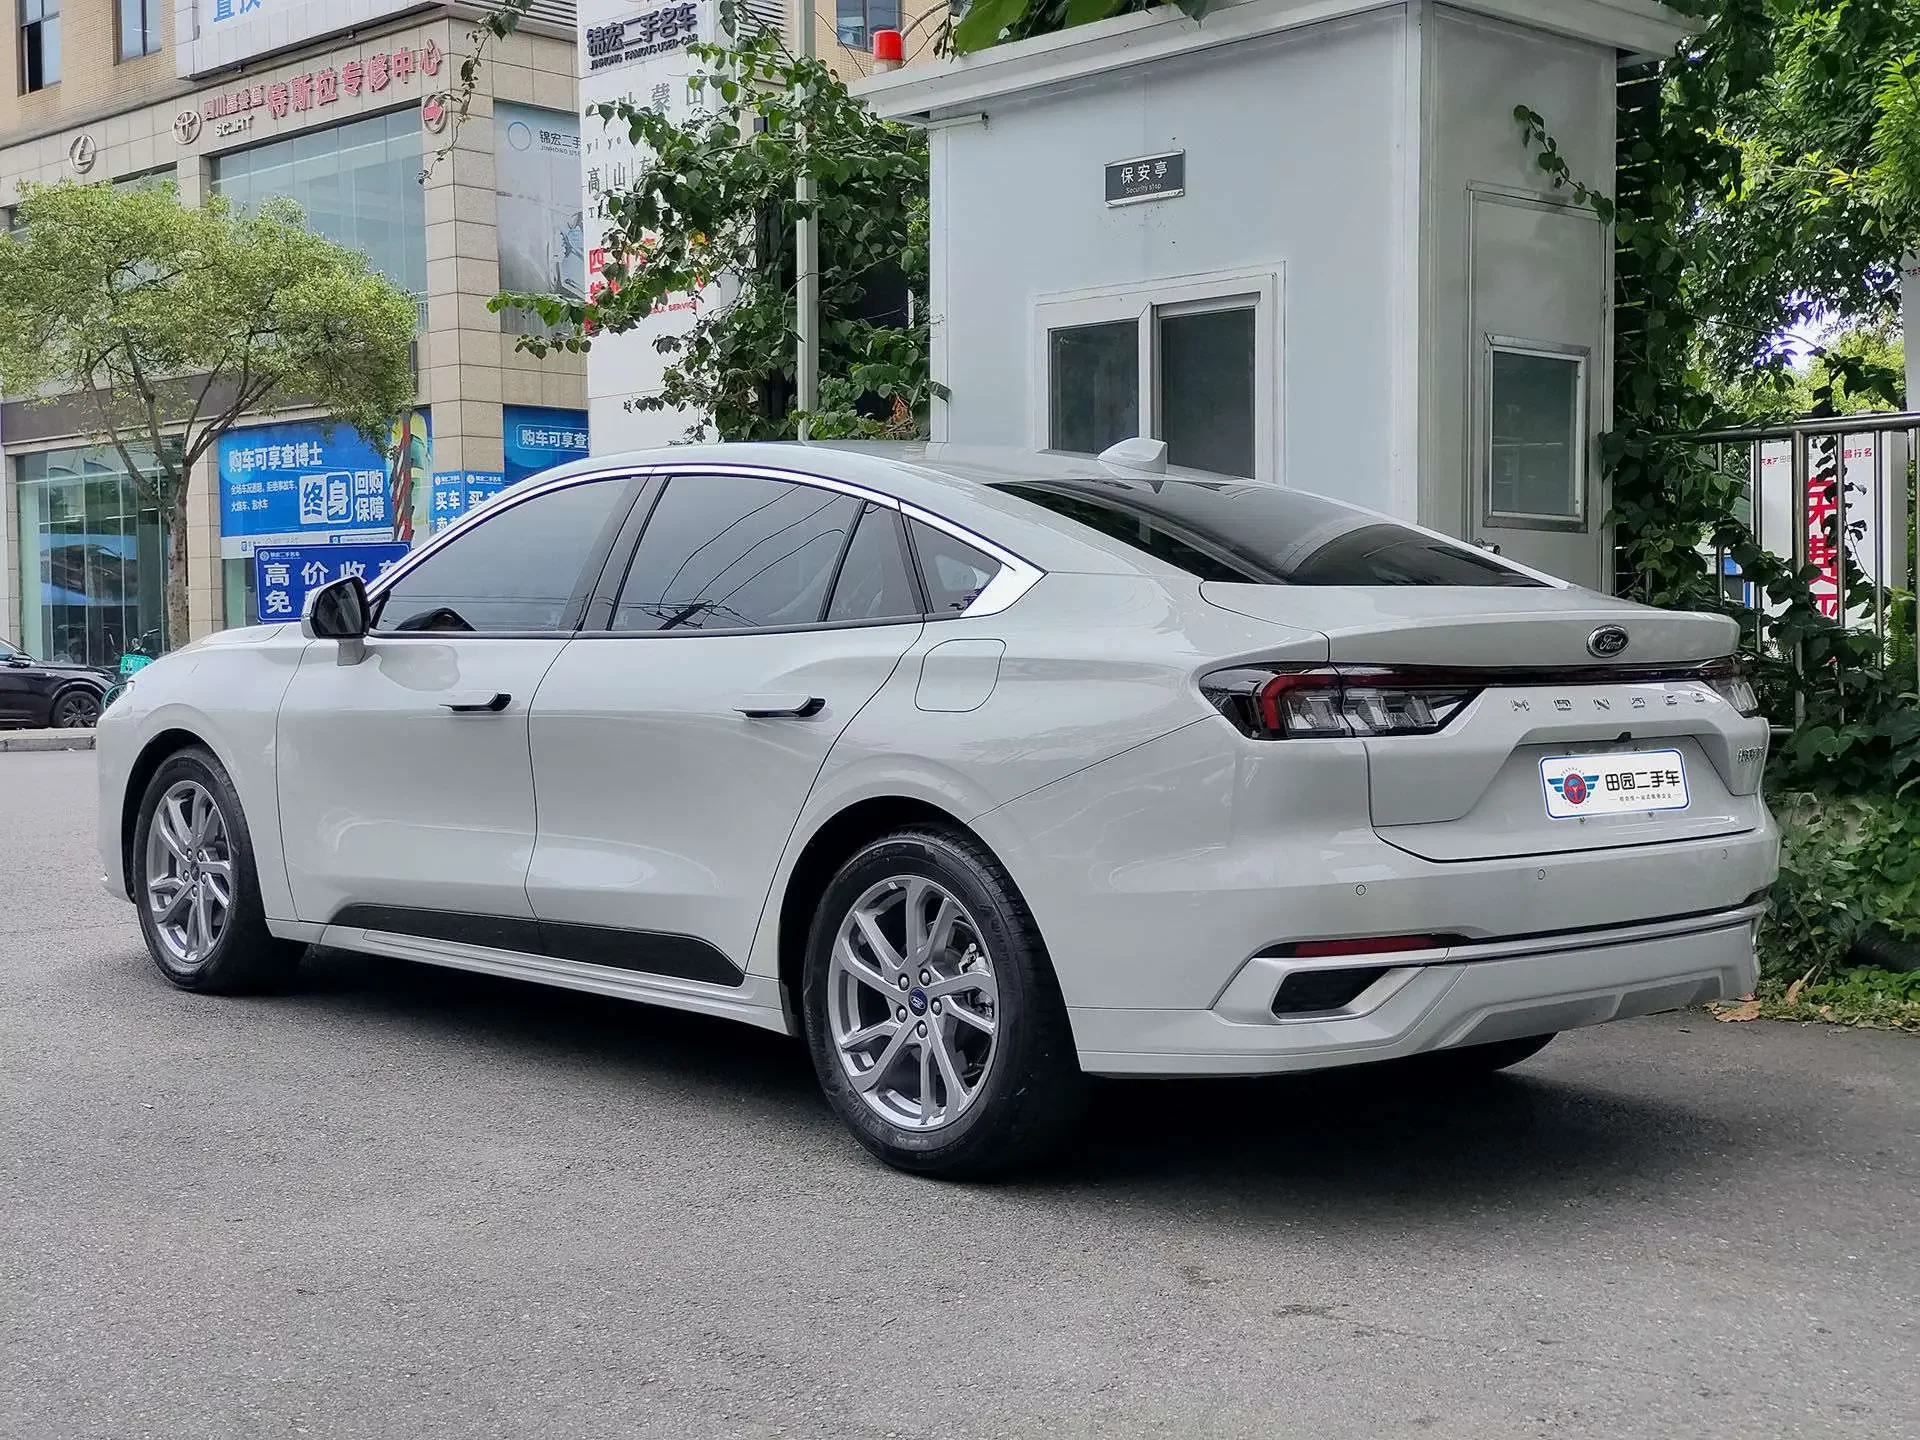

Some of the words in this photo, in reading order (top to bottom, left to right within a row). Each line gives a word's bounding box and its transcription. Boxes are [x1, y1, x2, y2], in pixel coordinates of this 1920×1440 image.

[586, 3, 698, 57] 锦宏二手名车
[266, 38, 442, 119] 特斯拉专修中心
[1121, 160, 1168, 184] 保安亭
[229, 442, 323, 472] 购车可享查博士
[355, 470, 384, 495] 回购
[303, 480, 349, 517] 终身
[355, 497, 385, 522] 保障
[436, 489, 460, 511] 买车
[1600, 633, 1624, 650] Ford
[1511, 691, 1705, 712] MONDEO
[1605, 769, 1681, 791] 田园二手车
